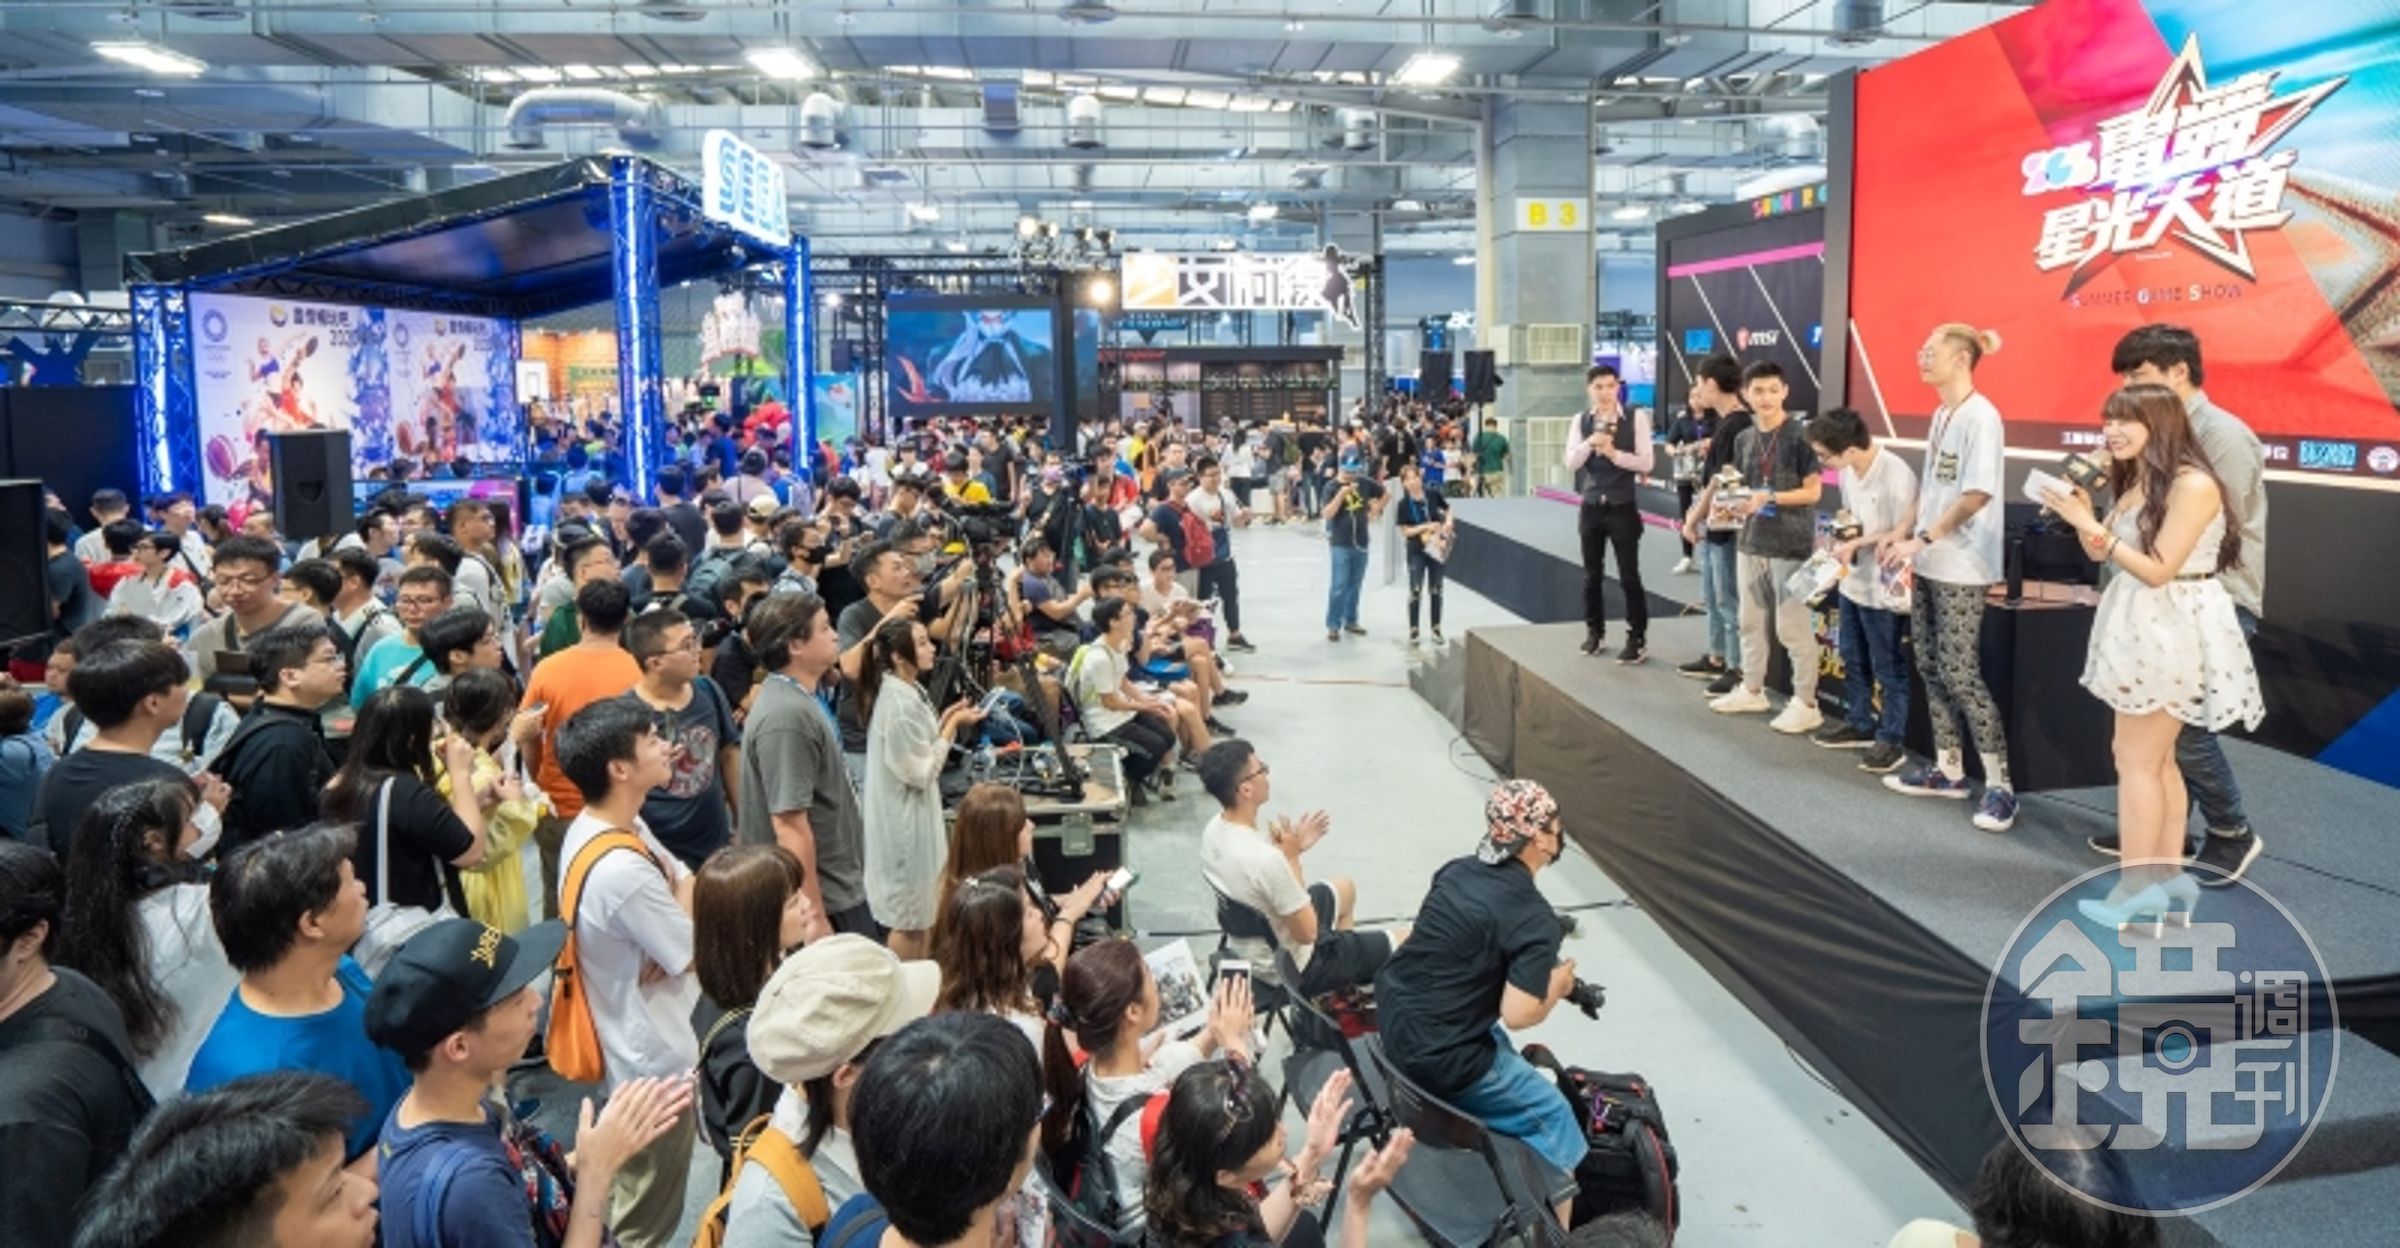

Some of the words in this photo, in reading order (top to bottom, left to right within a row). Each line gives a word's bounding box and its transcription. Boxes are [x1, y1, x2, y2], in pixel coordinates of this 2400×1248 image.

[718, 137, 788, 238] SEGA
[1528, 202, 1548, 228] B
[1558, 202, 1578, 228] 3
[2033, 148, 2298, 271] 星光大道
[2189, 282, 2242, 300] SHOW
